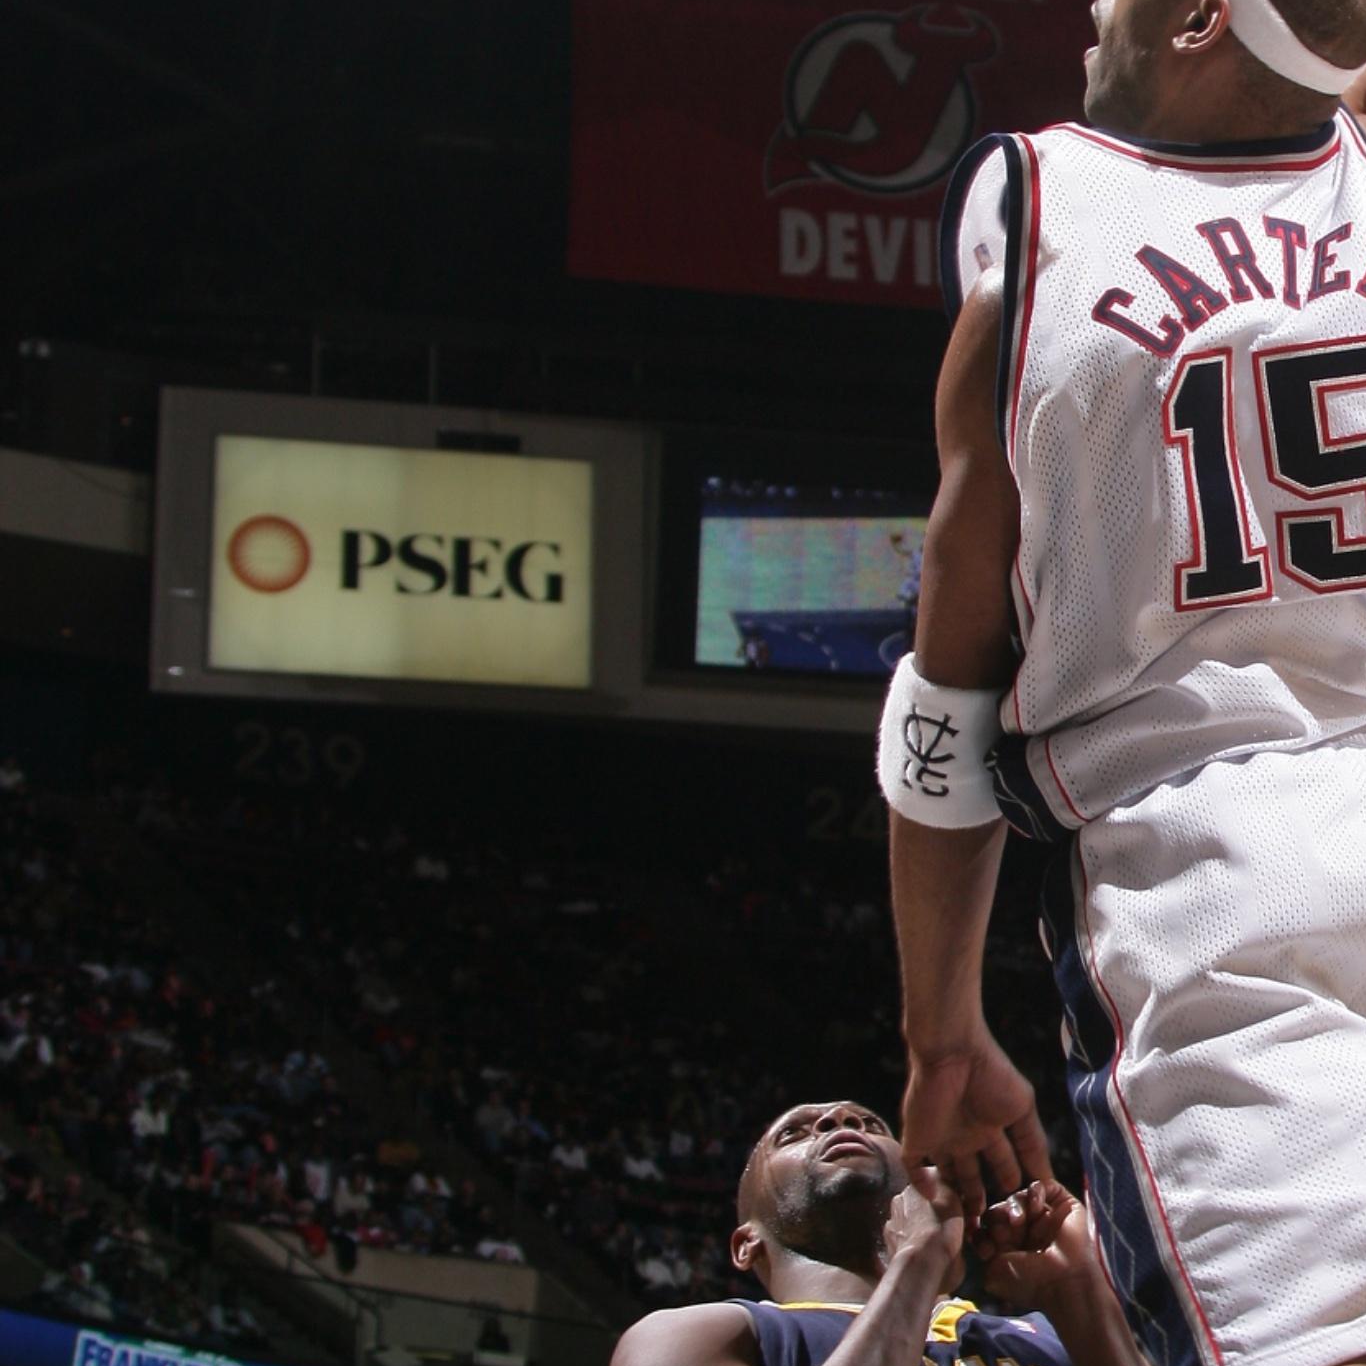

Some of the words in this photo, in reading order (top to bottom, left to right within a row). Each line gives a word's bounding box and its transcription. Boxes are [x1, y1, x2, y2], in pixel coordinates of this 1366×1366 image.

[779, 208, 940, 287] DEVI
[341, 529, 565, 604] PSEG
[233, 720, 366, 792] 239
[804, 784, 884, 845] 24
